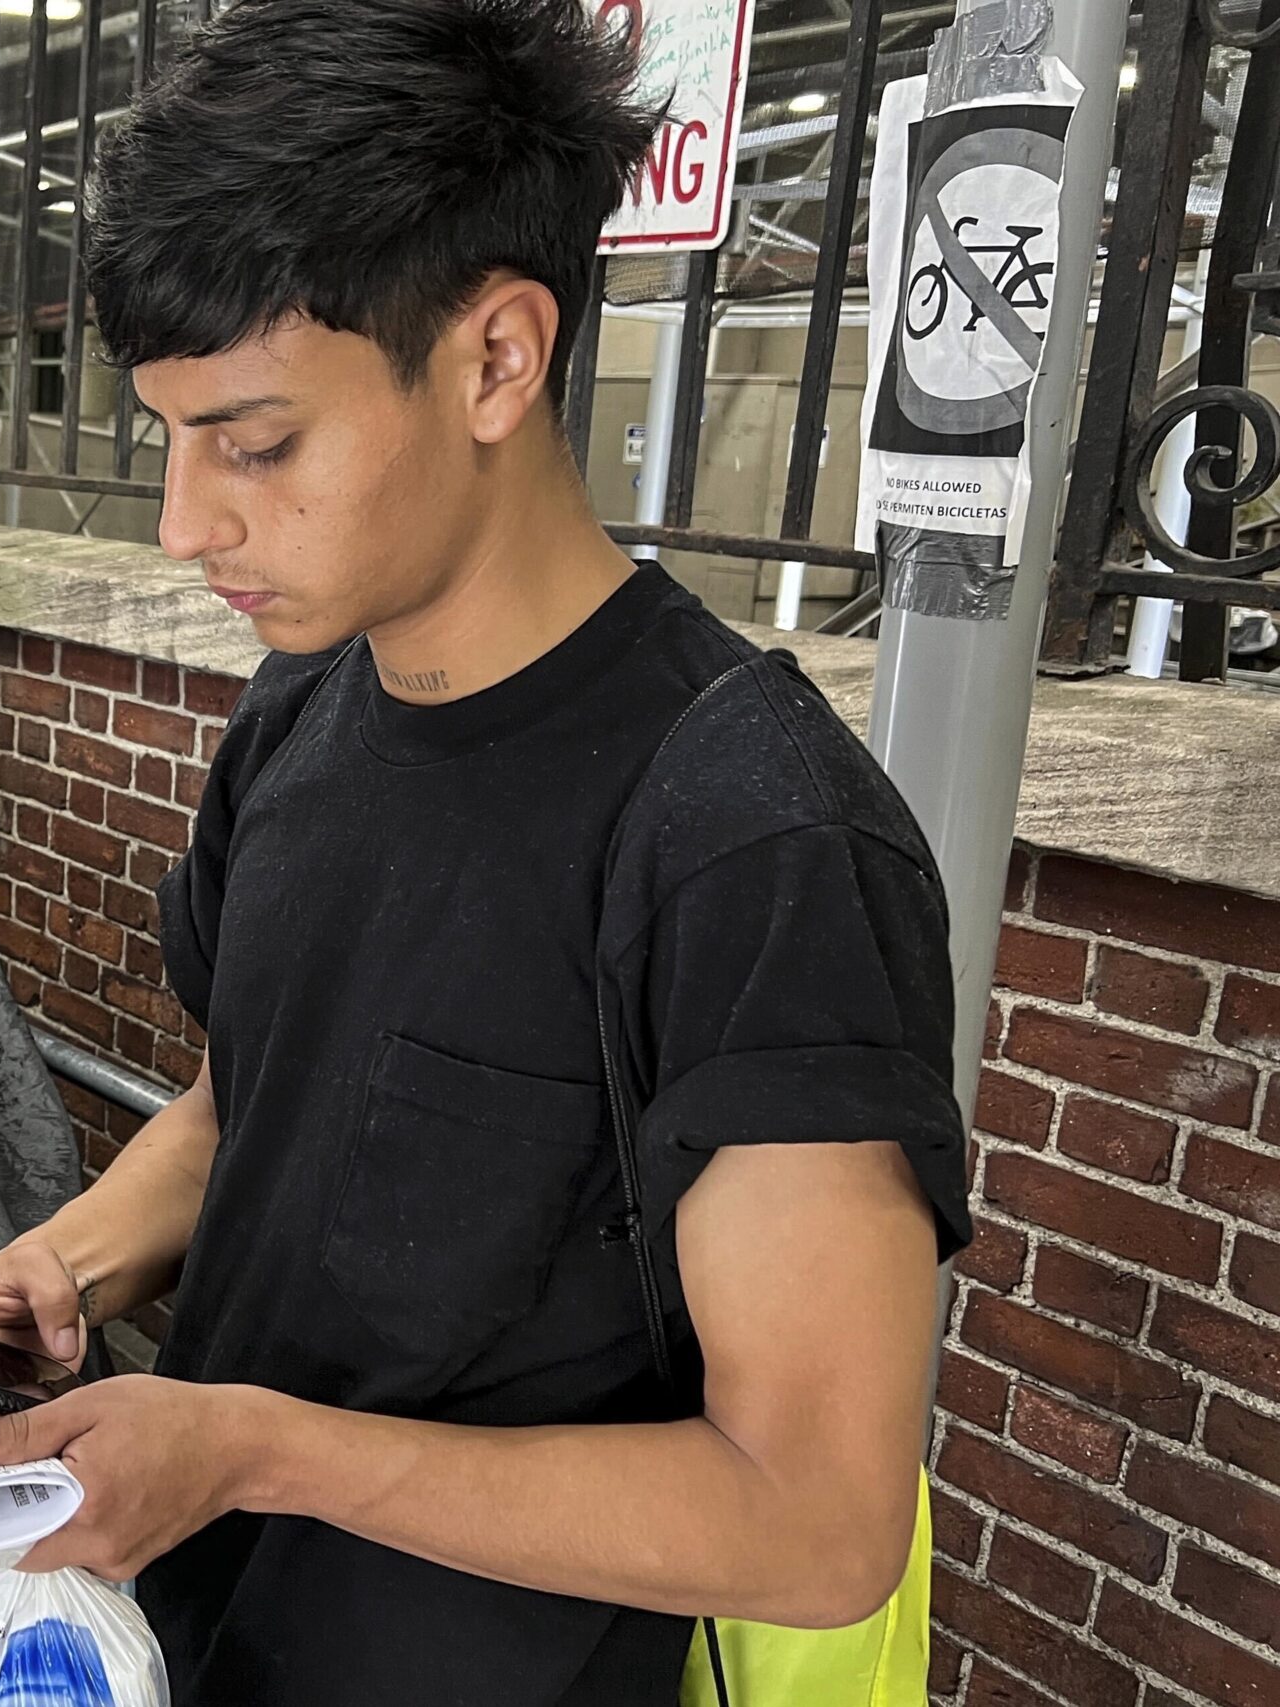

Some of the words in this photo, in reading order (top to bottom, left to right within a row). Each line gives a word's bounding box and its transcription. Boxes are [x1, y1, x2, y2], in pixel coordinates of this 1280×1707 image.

[885, 477, 895, 488] NO
[895, 478, 920, 490] BIKES
[922, 481, 982, 493] ALLOWED
[889, 502, 934, 516] PERMITEN
[937, 506, 1007, 518] BICICLETAS
